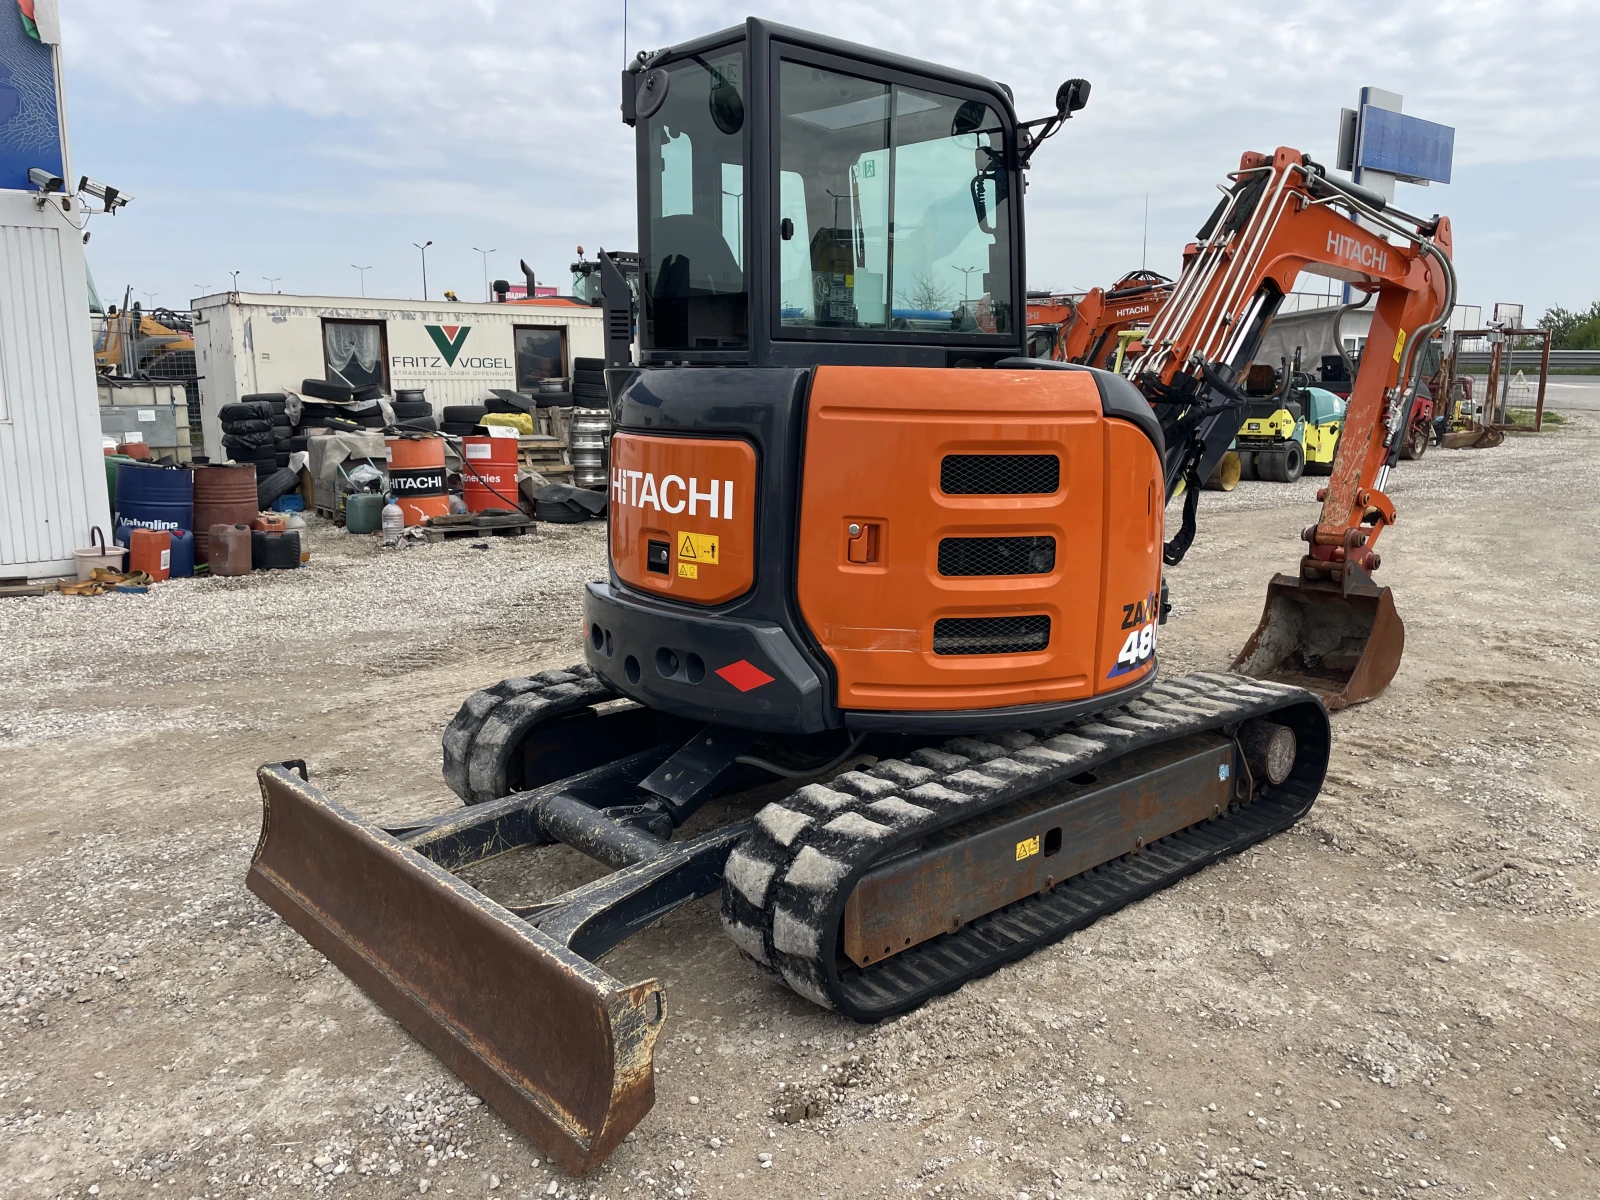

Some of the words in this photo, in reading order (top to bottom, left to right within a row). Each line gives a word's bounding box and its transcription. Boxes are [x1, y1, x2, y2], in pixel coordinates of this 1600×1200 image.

[1326, 230, 1388, 273] HITACHI
[1116, 305, 1150, 317] HITACHI
[392, 357, 442, 368] FRITZ
[459, 358, 513, 369] VOGEL
[389, 476, 442, 489] HITACHI
[464, 474, 501, 485] Energies
[612, 467, 733, 520] HITACHI
[120, 516, 179, 530] Valvoline
[1121, 591, 1159, 630] ZAXIS
